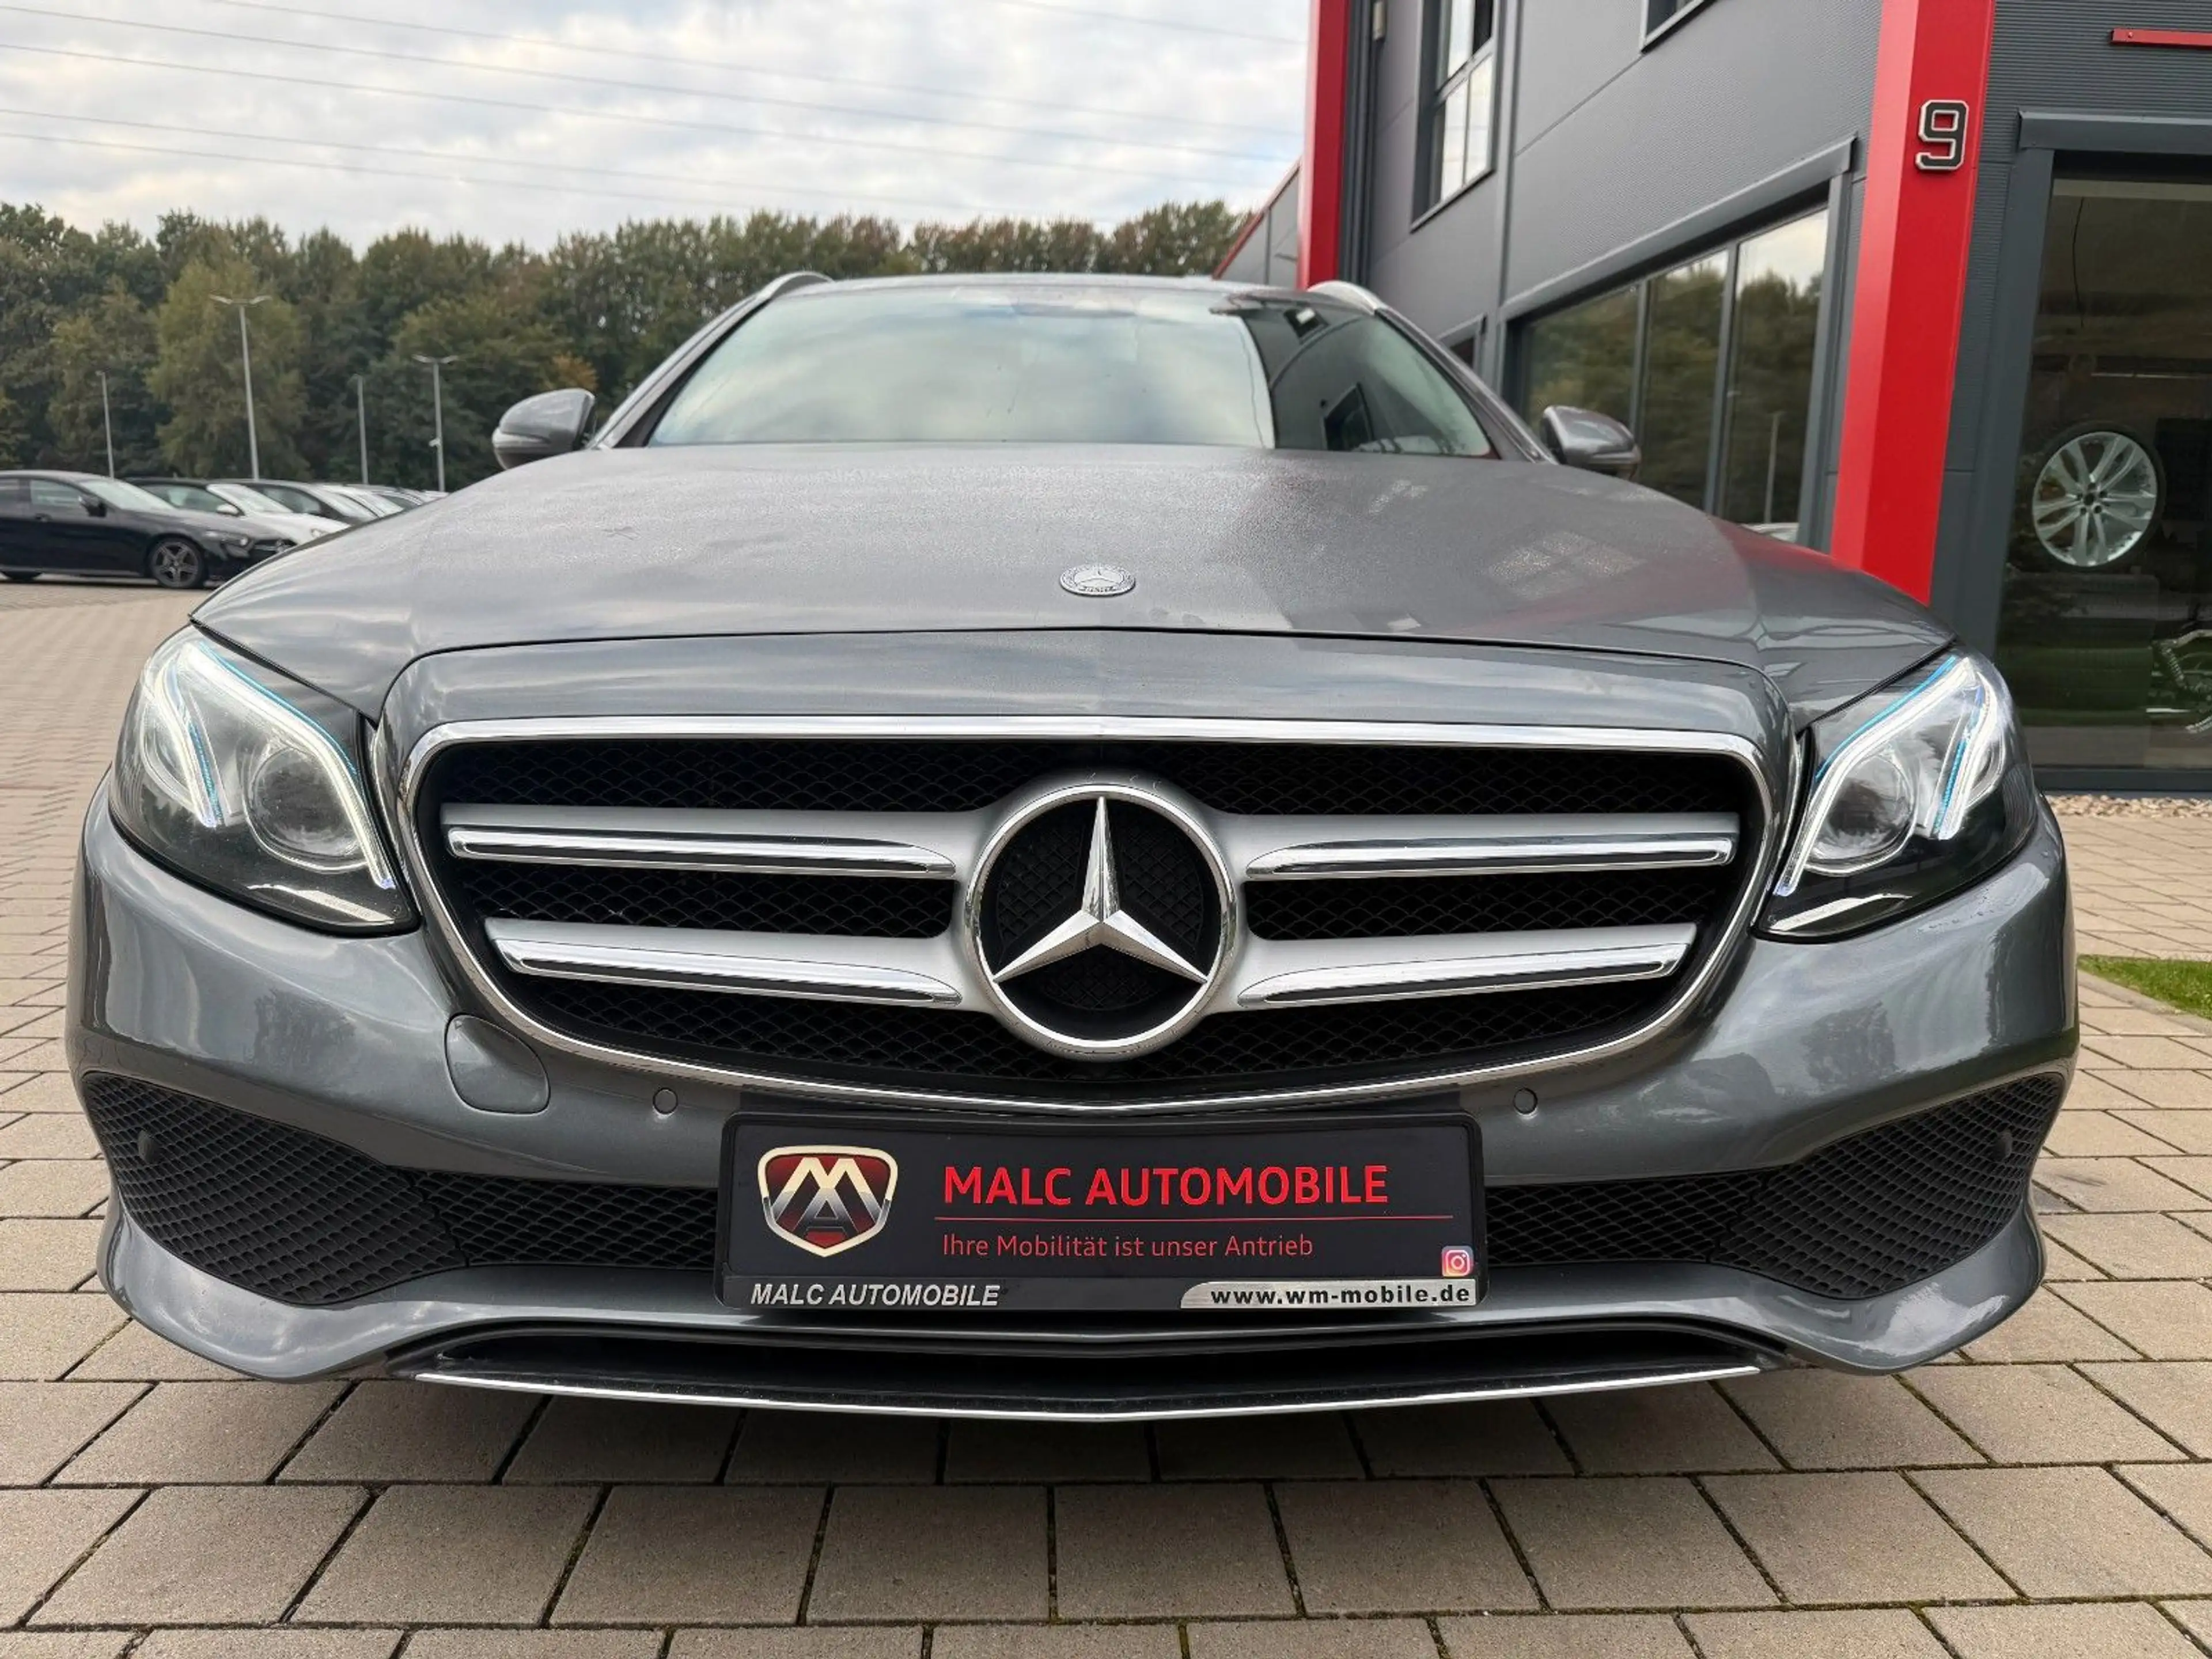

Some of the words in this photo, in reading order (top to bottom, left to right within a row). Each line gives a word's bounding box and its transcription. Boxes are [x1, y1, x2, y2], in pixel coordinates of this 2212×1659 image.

[1915, 100, 1969, 171] 9
[945, 1166, 1071, 1206] MALC
[1085, 1165, 1388, 1207] AUTOMOBILE
[942, 1233, 988, 1256] Ihre
[997, 1234, 1107, 1257] Mobilität
[1115, 1236, 1145, 1257] ist
[1152, 1238, 1217, 1257] unser
[1225, 1233, 1313, 1256] Antrieb
[751, 1283, 824, 1305] MALC
[828, 1284, 1001, 1306] AUTOMOBILE
[1211, 1284, 1471, 1305] www.wm-mobile.de
